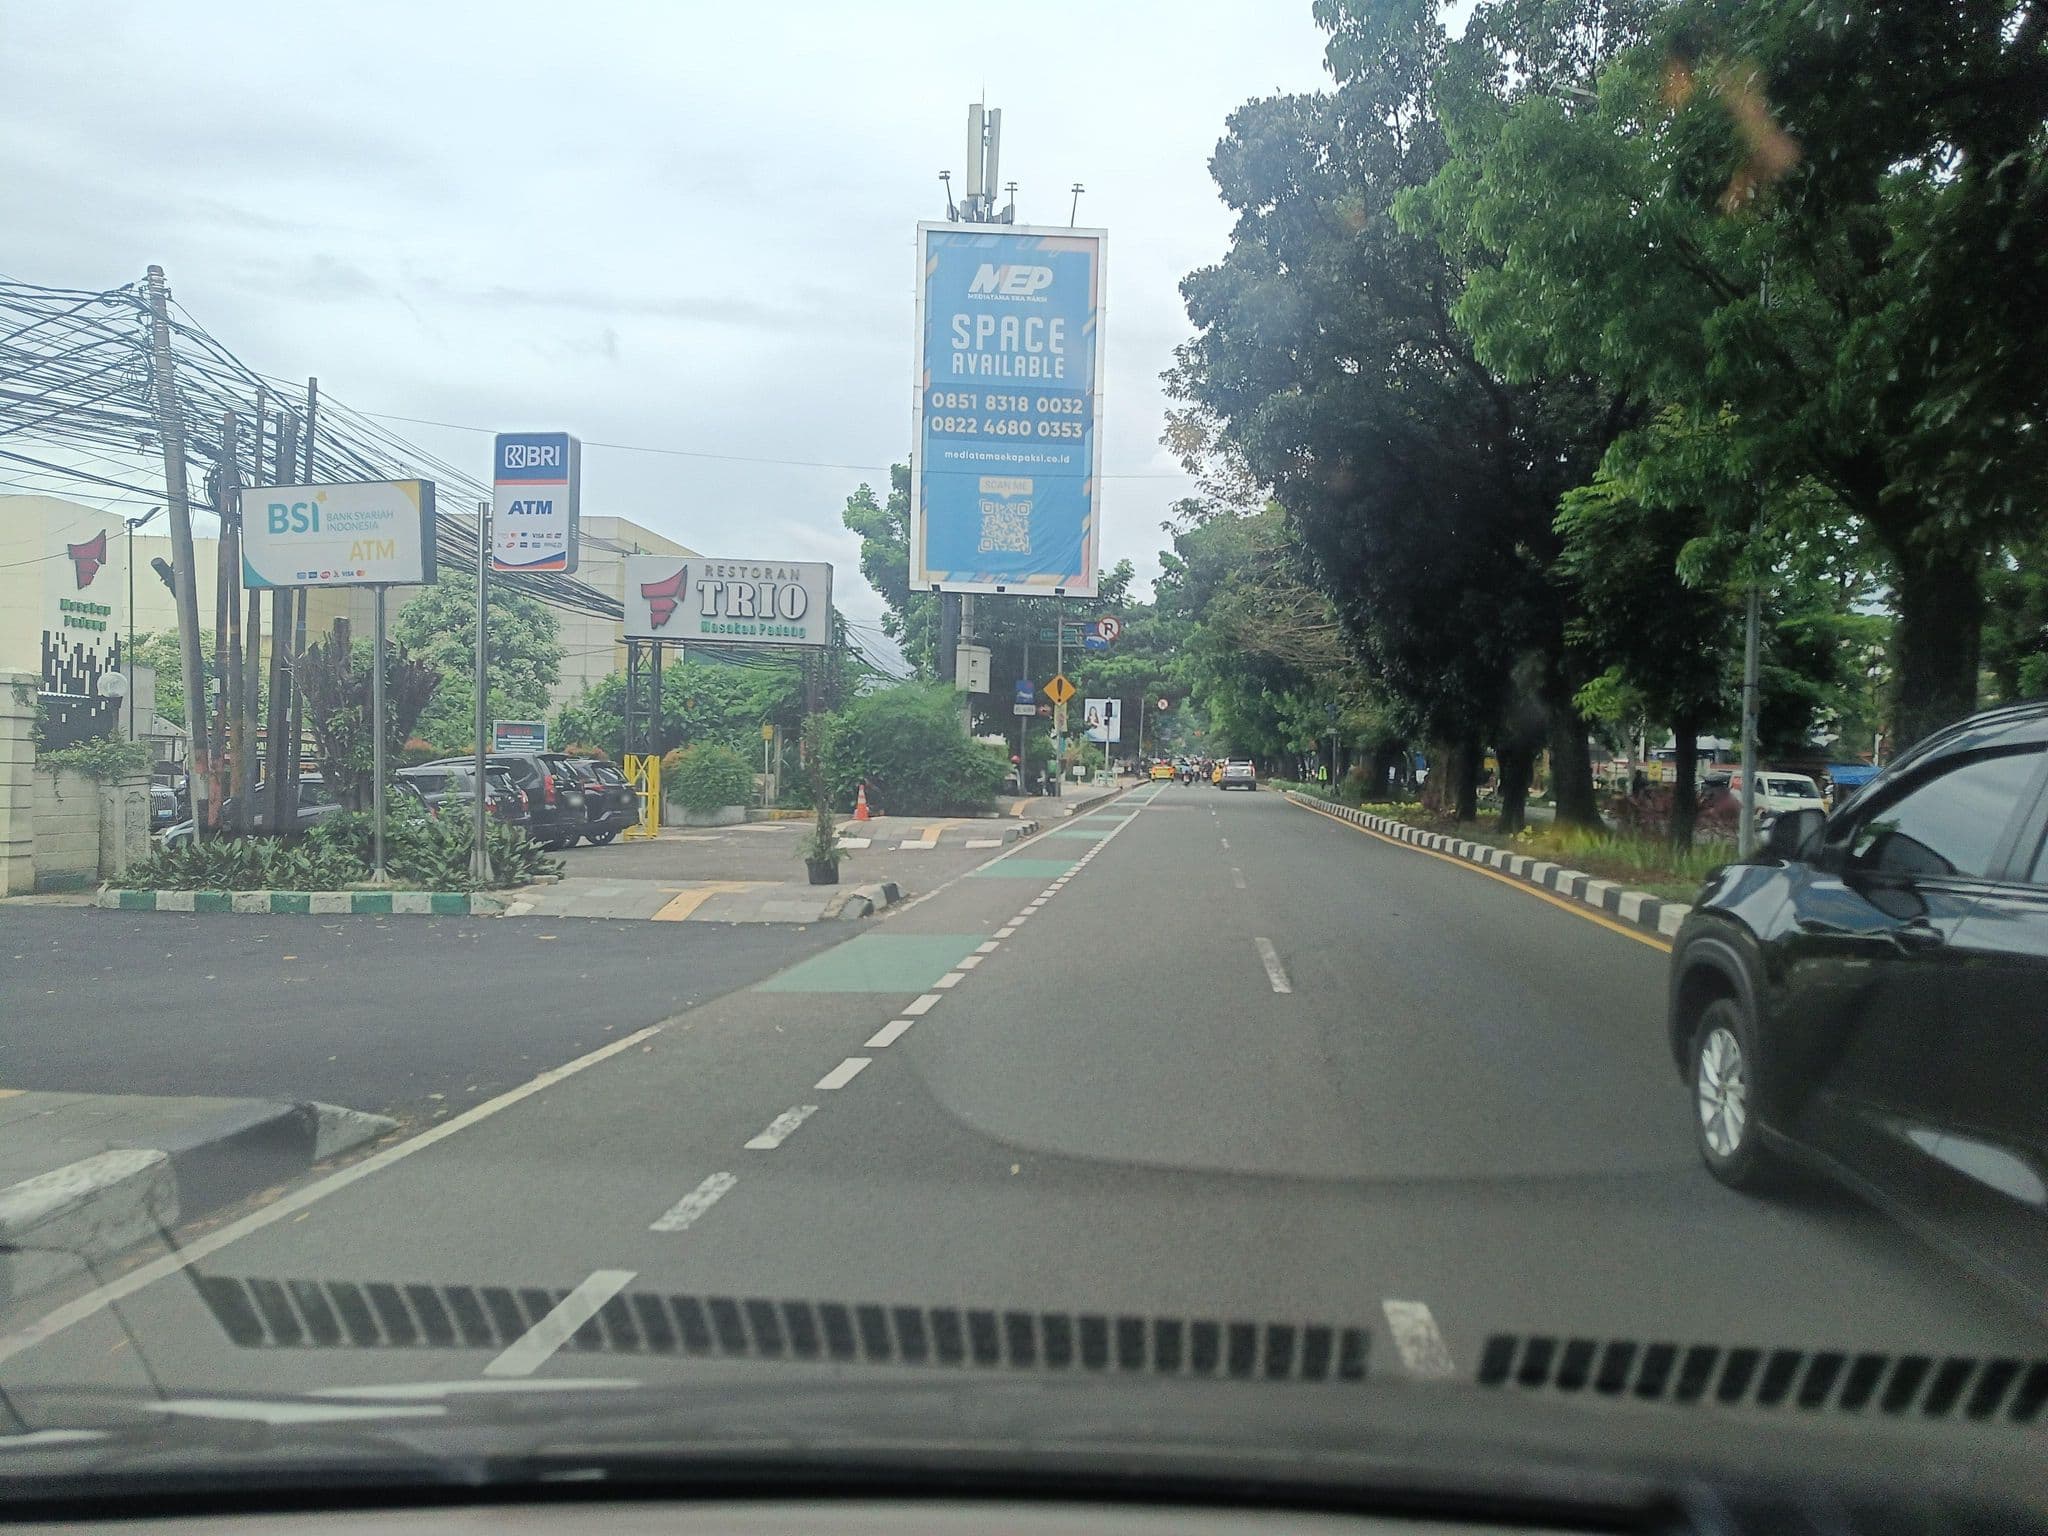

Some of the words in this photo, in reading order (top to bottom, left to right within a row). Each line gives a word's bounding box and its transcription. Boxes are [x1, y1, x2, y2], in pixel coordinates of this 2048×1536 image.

[968, 263, 1054, 295] MEP
[951, 313, 1065, 355] SPACE
[952, 352, 1065, 379] AVAILABLE
[931, 392, 977, 410] 0851
[985, 394, 1029, 413] 8318
[1036, 397, 1083, 415] 0032
[931, 416, 978, 434] 0822
[983, 418, 1032, 437] 4680
[1037, 421, 1083, 439] 0353
[526, 445, 561, 467] BRI
[944, 450, 1071, 464] mediatamaekapaksi.co.id
[267, 501, 320, 534] BSI
[326, 511, 353, 521] BANK
[354, 510, 394, 521] SYARIAH
[508, 500, 553, 515] ATM
[327, 520, 379, 532] INDONESIA
[350, 538, 395, 561] ATM
[704, 564, 800, 581] RESTORAN
[695, 579, 809, 621] TRIO
[701, 620, 756, 636] Masakan
[759, 622, 807, 639] Padang
